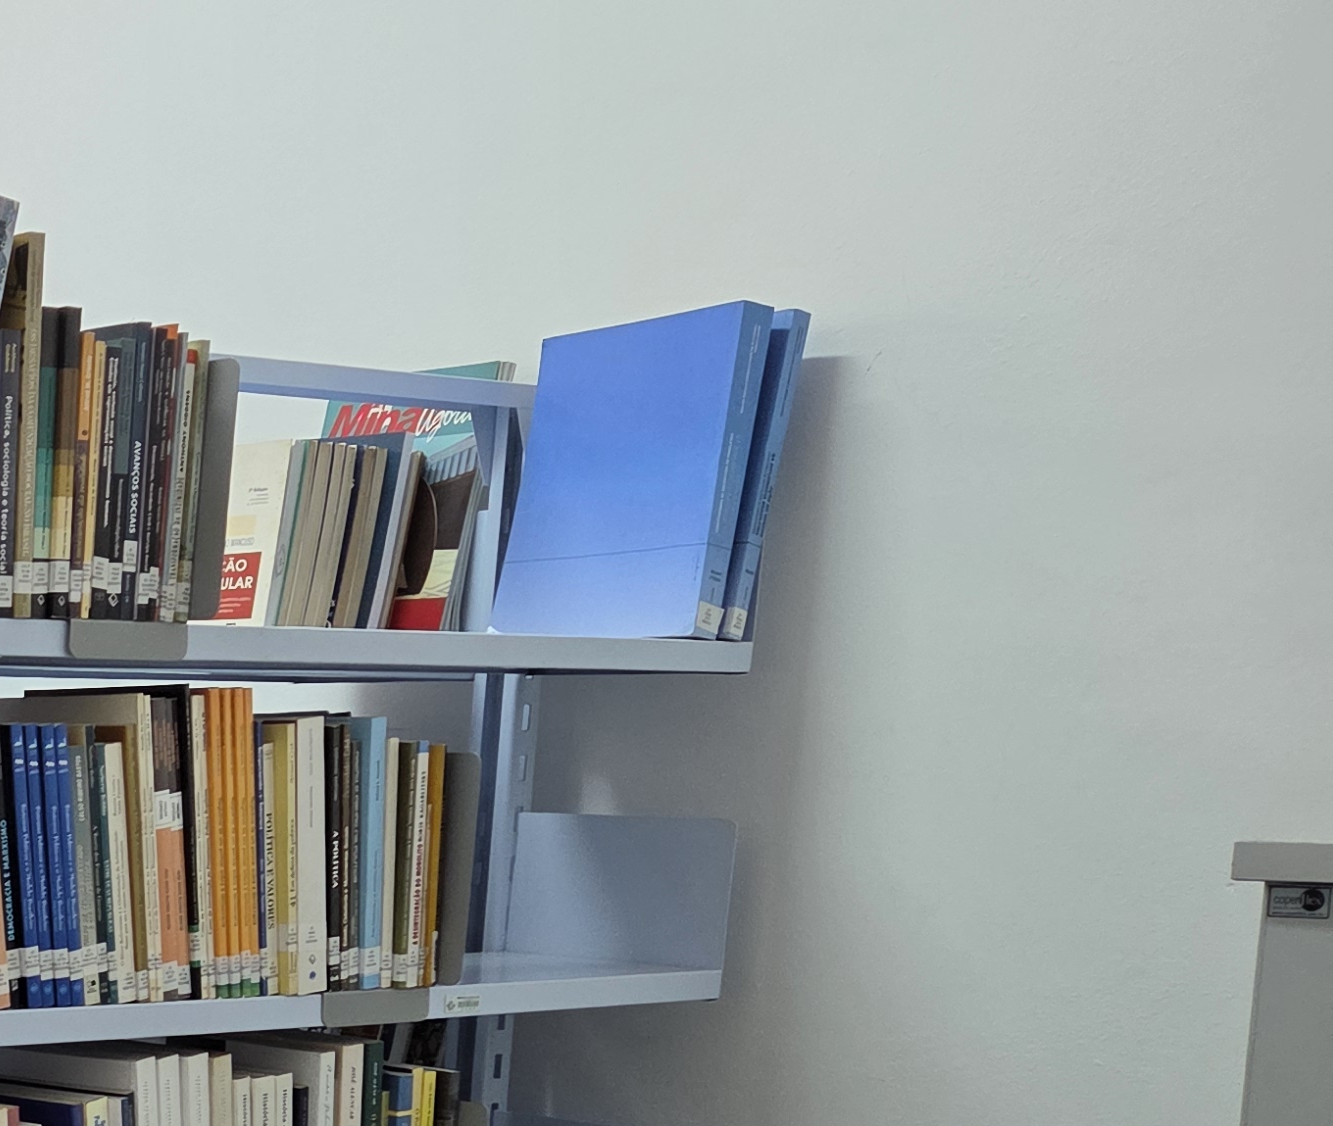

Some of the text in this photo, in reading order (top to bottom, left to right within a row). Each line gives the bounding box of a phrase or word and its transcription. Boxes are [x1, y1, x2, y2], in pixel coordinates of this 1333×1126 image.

[2, 395, 14, 439] Política,
[0, 441, 12, 491] sociologia
[127, 440, 143, 534] AVANÇOS SOCIAIS
[0, 501, 10, 540] teoria
[0, 818, 10, 870] MARXISMO
[265, 812, 275, 866] POLÍTICA
[3, 878, 15, 942] DEMOCRACIA
[266, 875, 276, 930] VALORES
